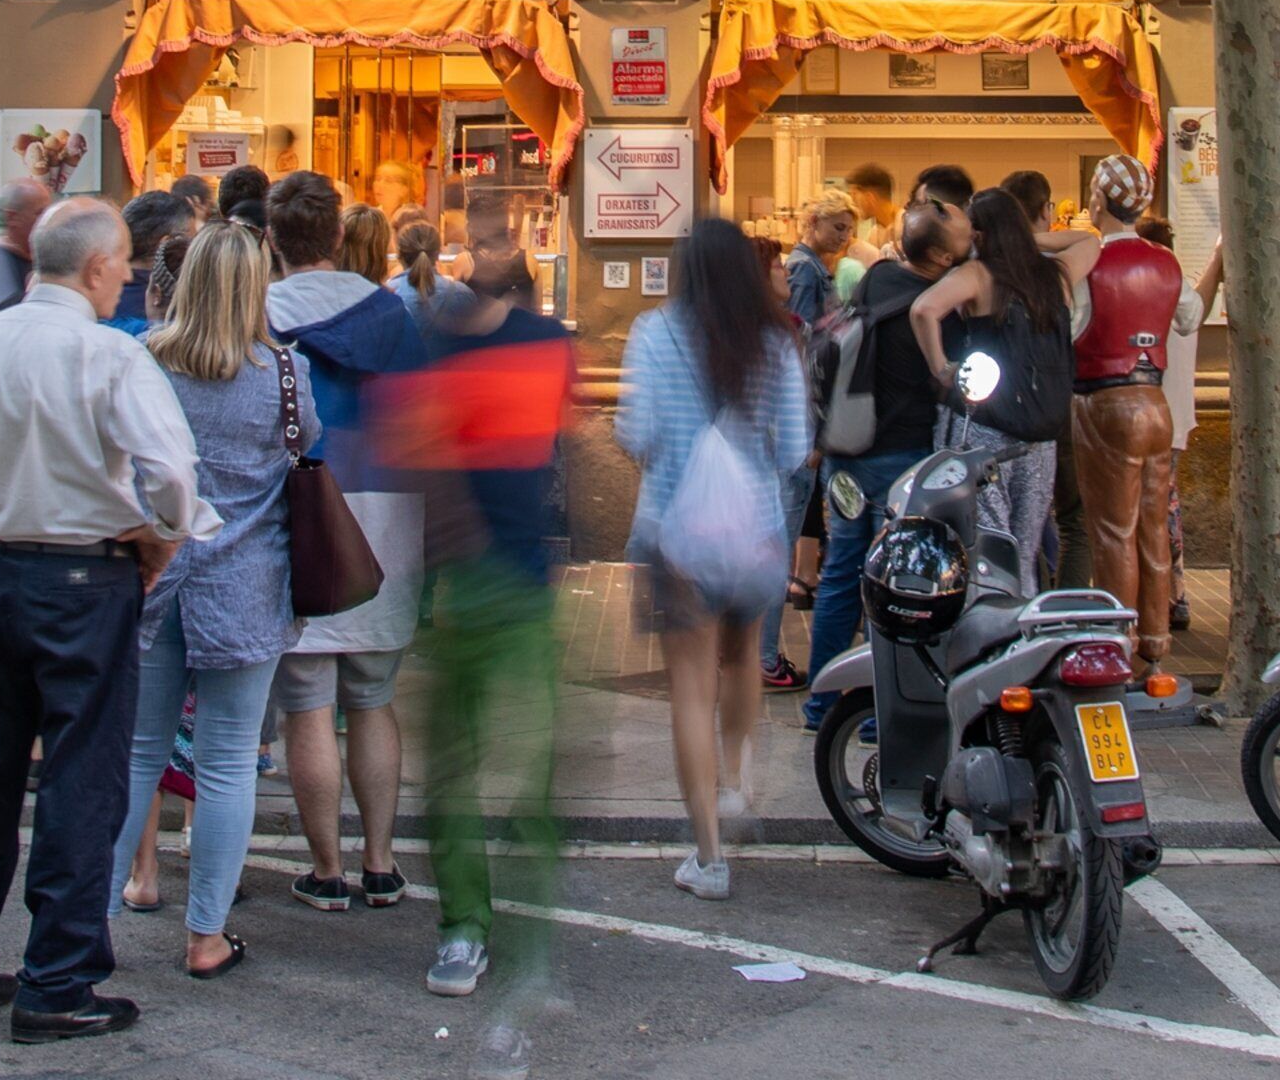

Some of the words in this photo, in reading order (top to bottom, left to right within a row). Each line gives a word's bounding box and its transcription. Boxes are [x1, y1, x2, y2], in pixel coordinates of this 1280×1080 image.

[615, 63, 664, 74] Alarma
[614, 74, 664, 83] conectada
[609, 153, 674, 164] CUCURUTXOS
[605, 200, 650, 211] ORXATES
[597, 219, 656, 230] GRANISSATS
[1096, 752, 1126, 769] BLP
